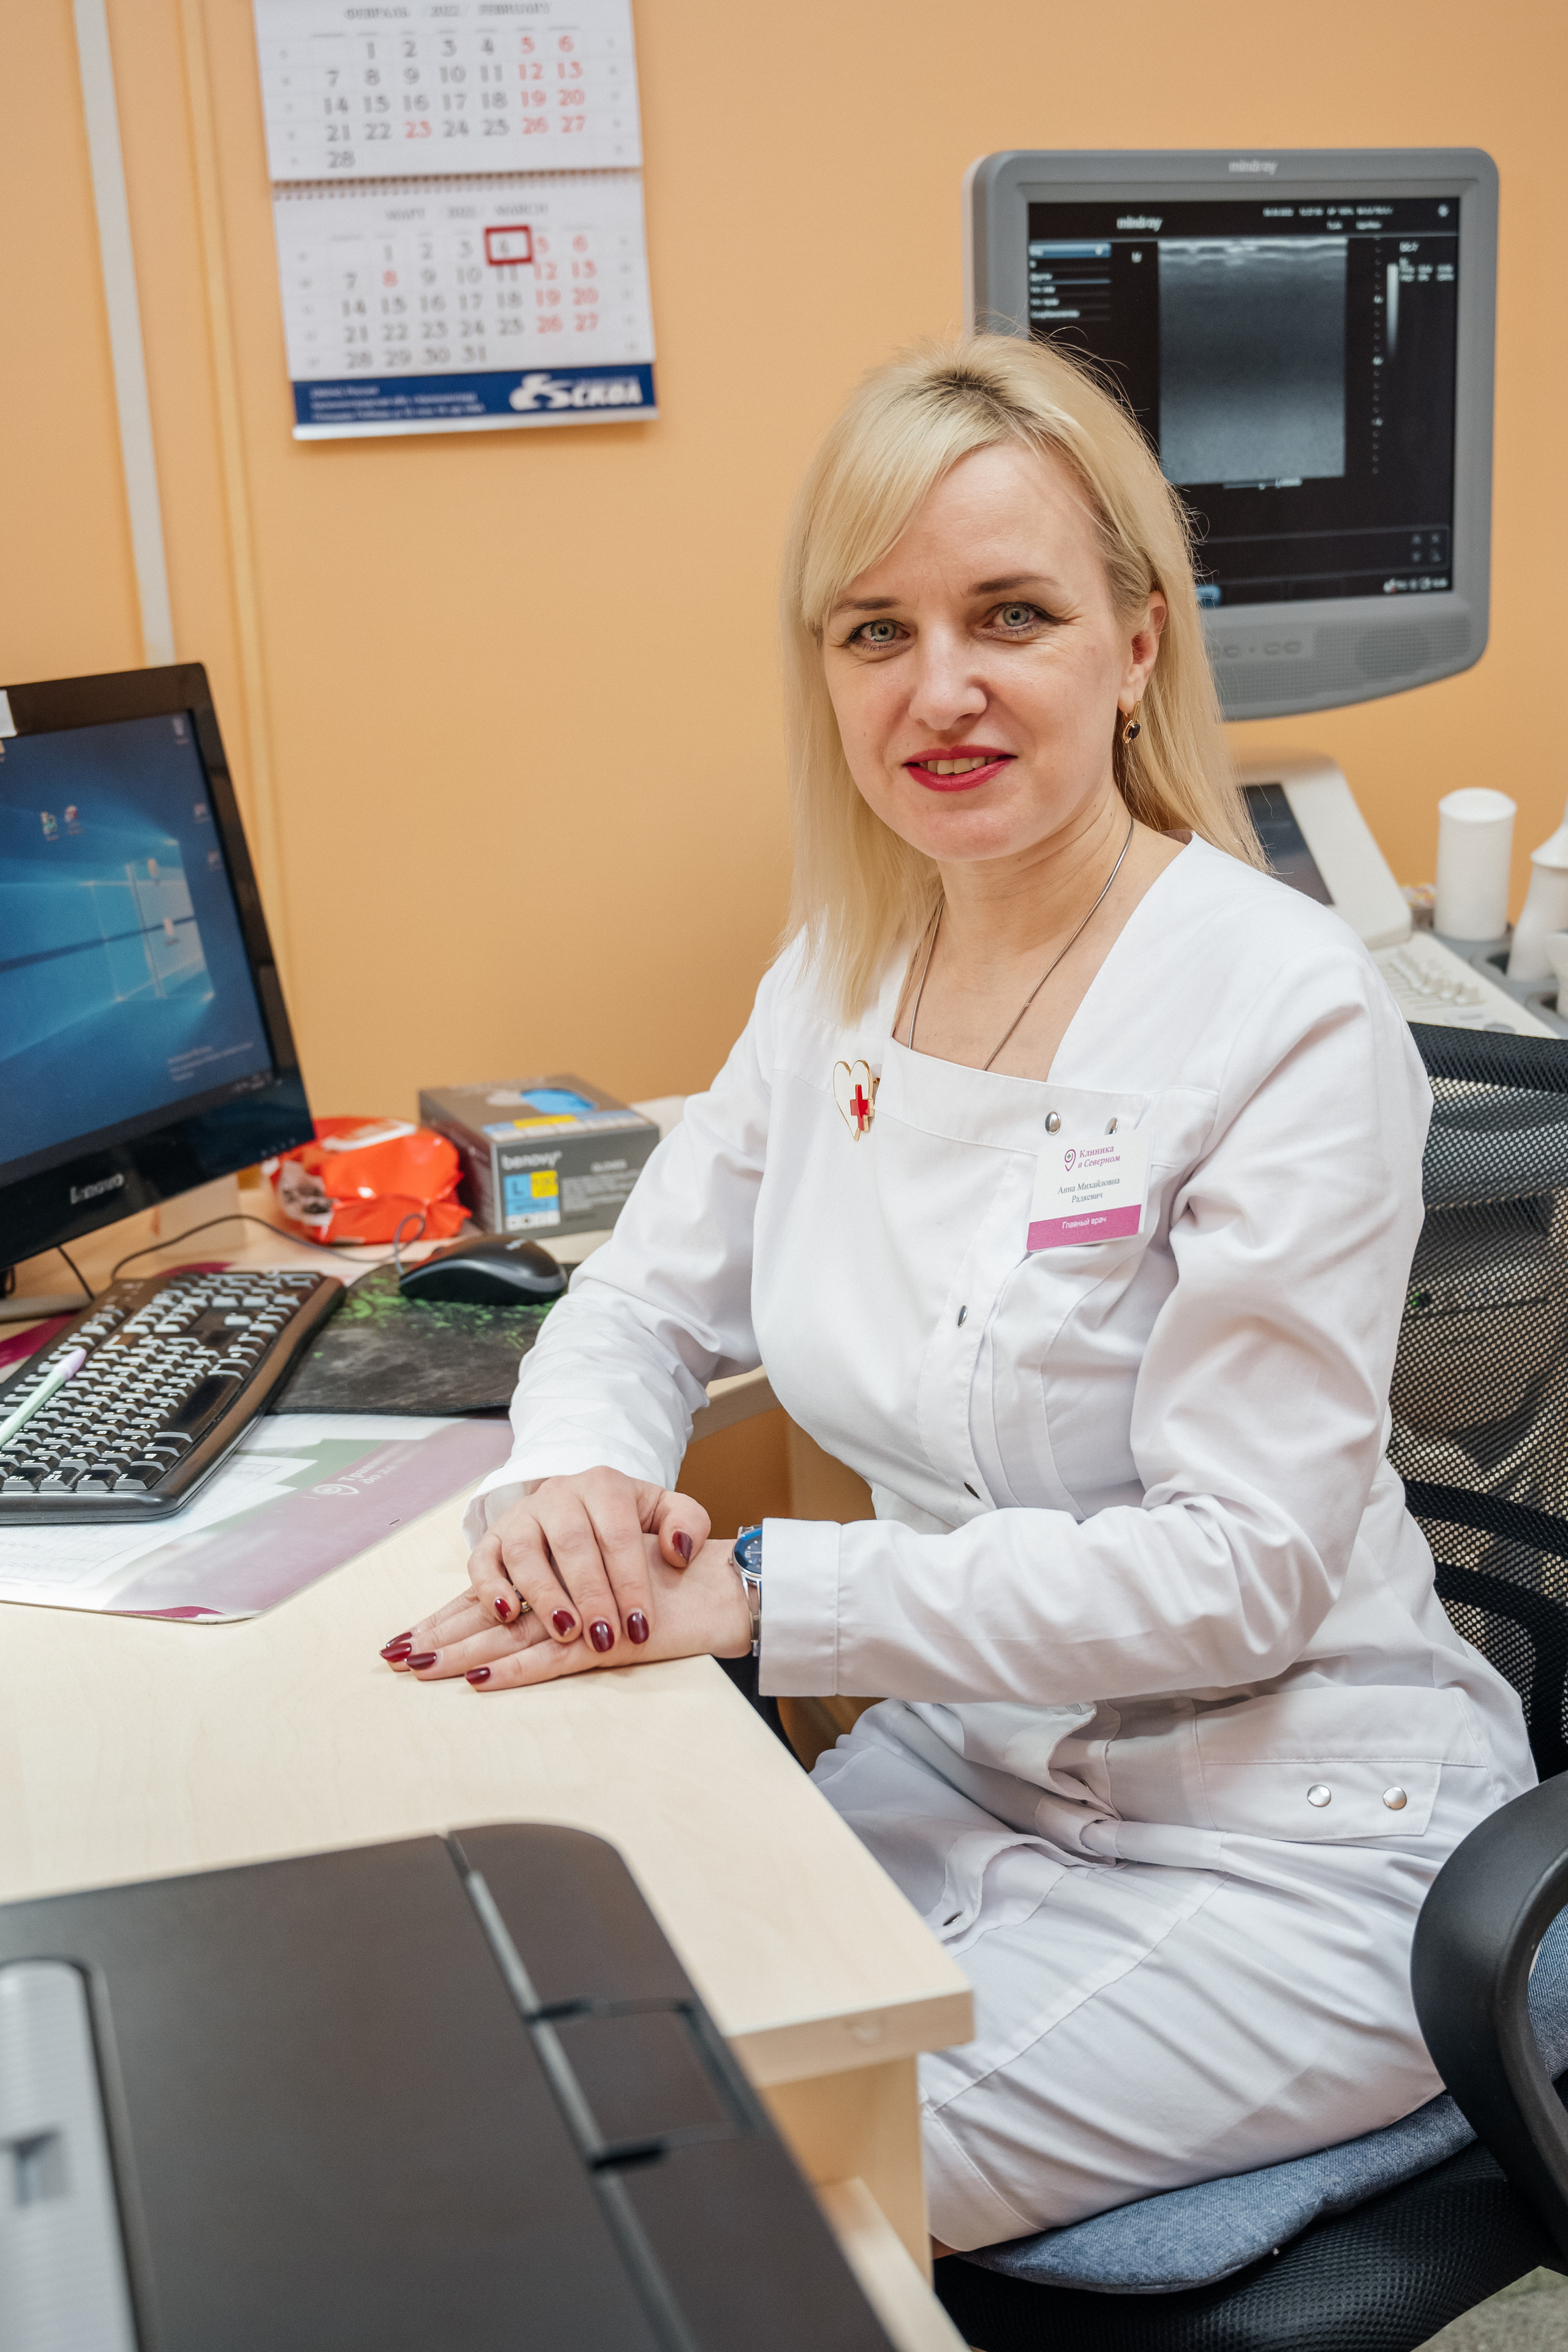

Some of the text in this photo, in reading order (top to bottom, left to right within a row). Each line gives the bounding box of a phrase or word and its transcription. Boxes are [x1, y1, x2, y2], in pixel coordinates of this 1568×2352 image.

[366, 35, 575, 60] 1 2 3 4 5 6
[326, 60, 584, 87] 7 8 9 10 11 12 13
[324, 88, 586, 116] 14 15 16 17 18 19 20
[326, 114, 587, 143] 21 22 23 24 25 26 27
[328, 151, 356, 169] 28
[1229, 160, 1278, 175] mindray
[1116, 215, 1163, 232] mindray
[342, 287, 600, 317] 14 15 16 17 18 19 20
[1079, 1146, 1114, 1158] Клиника
[1084, 1155, 1120, 1168] Северном
[1077, 1178, 1120, 1191] Михайловна
[1071, 1193, 1103, 1204] Радкевич
[1062, 1216, 1107, 1229] Главный врач
